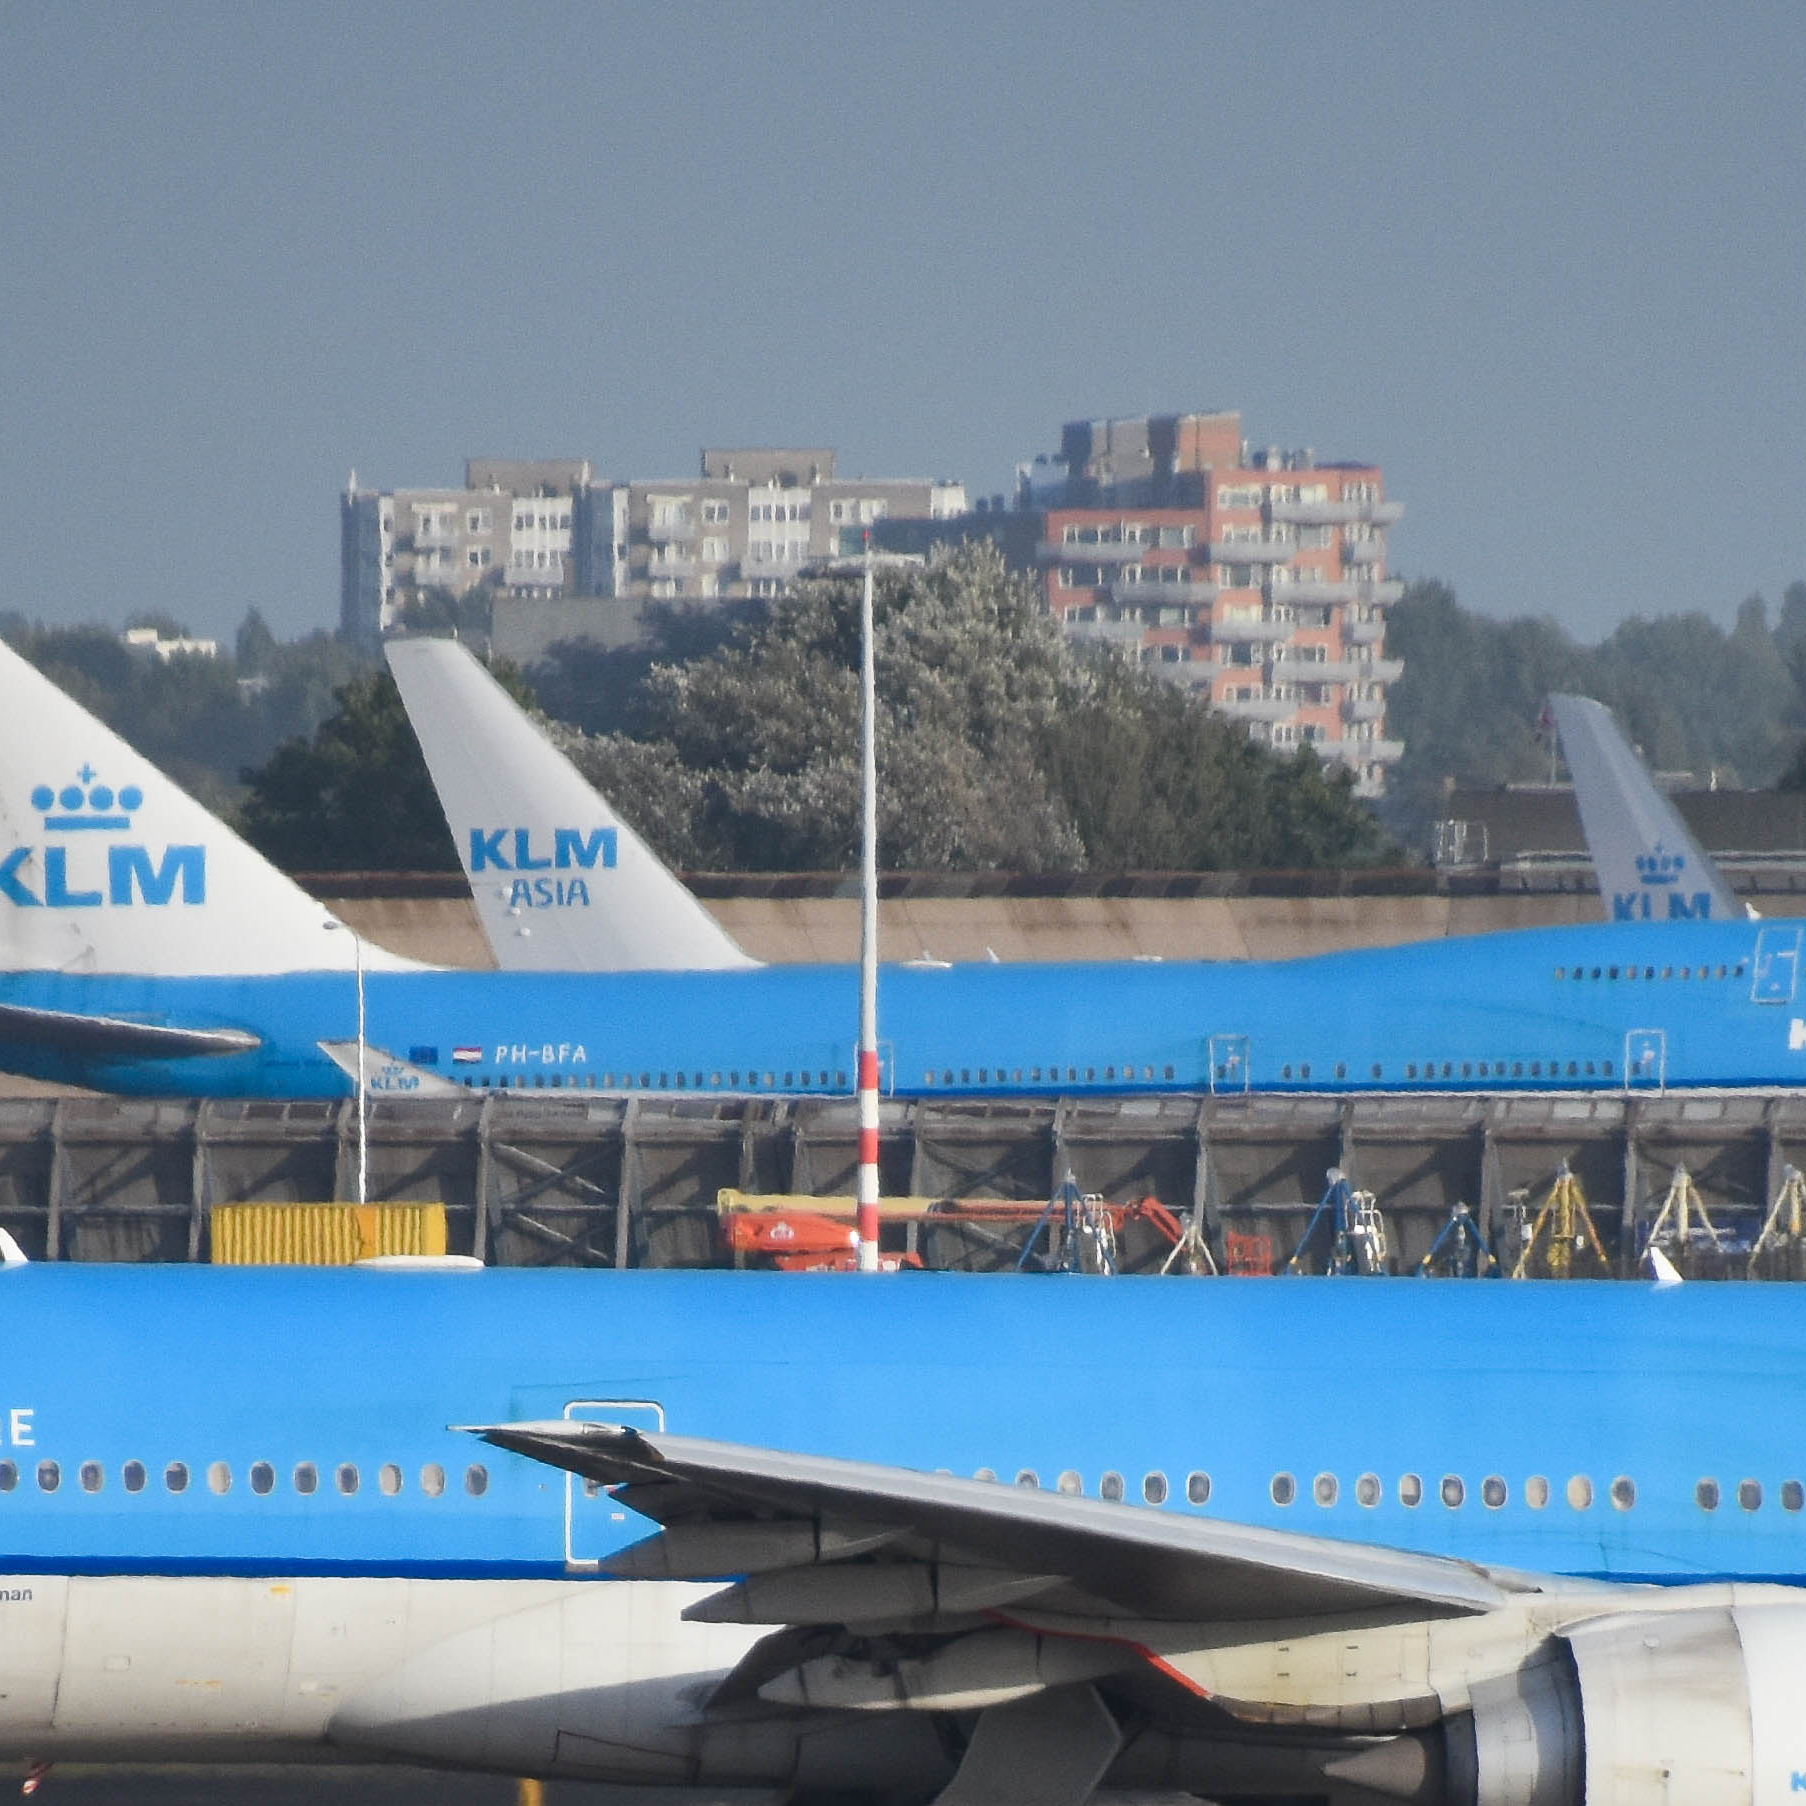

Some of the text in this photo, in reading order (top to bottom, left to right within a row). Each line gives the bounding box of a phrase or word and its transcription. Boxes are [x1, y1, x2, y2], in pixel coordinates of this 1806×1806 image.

[470, 828, 618, 870] KLM
[511, 876, 590, 907] ASIA
[495, 1044, 587, 1064] PH-BFA
